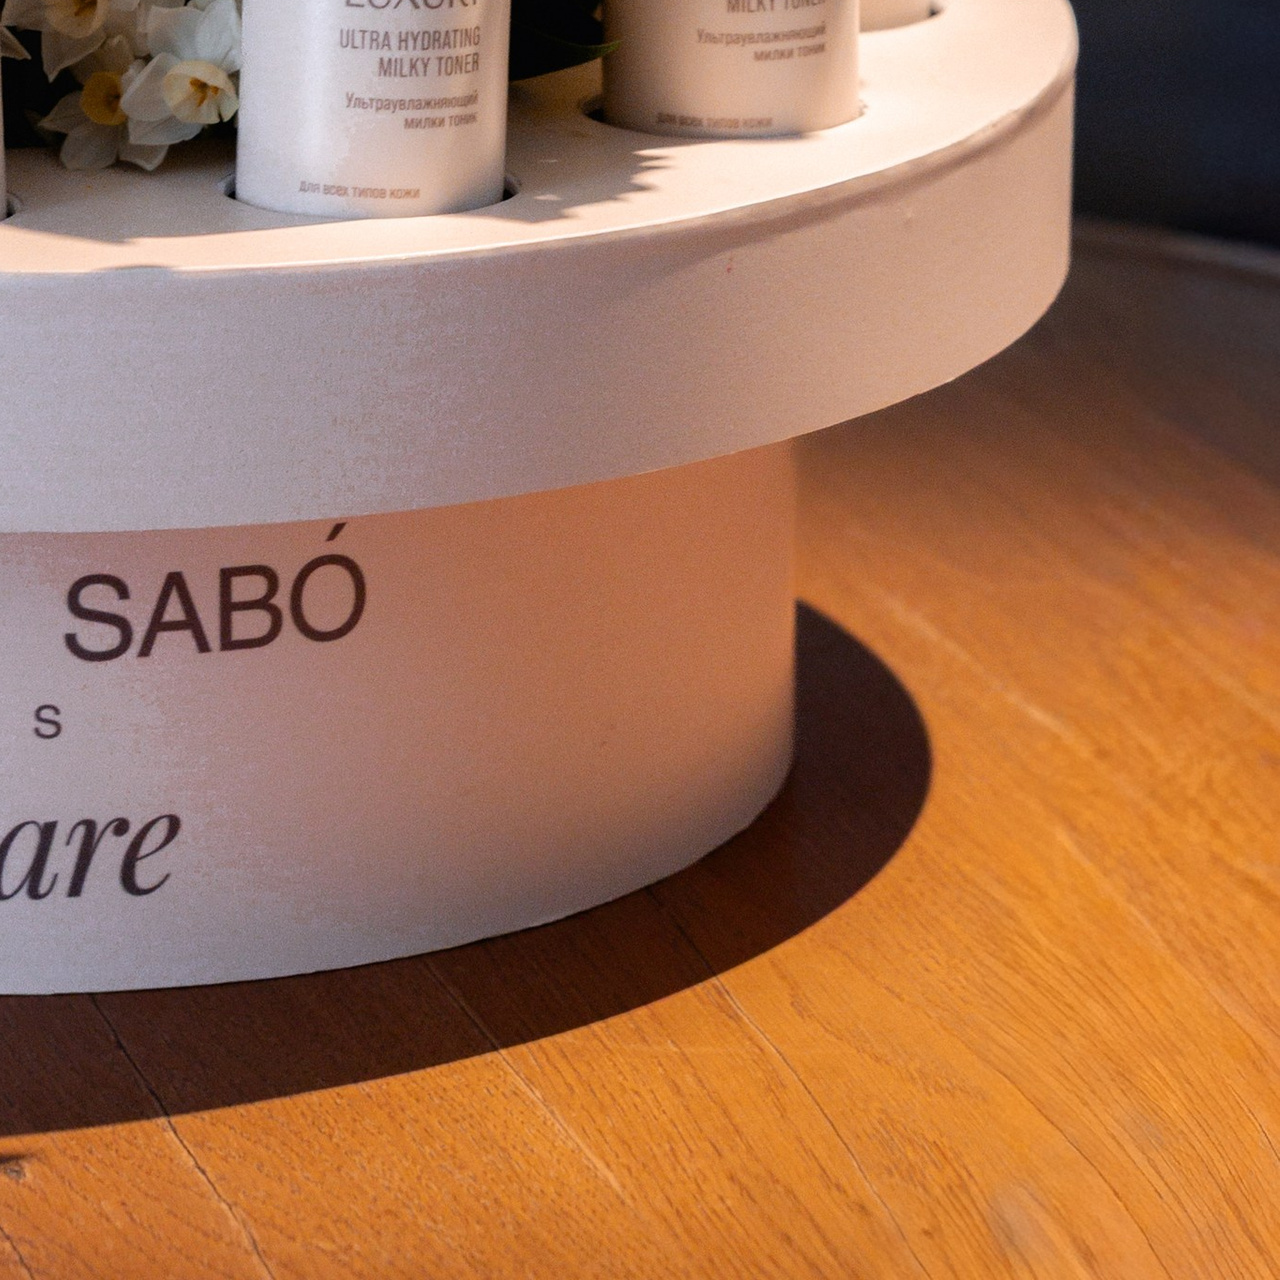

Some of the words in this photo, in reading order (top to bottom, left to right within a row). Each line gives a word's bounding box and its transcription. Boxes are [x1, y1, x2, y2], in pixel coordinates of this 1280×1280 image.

[339, 28, 392, 51] ULTRA
[397, 25, 481, 51] HYDRATING
[378, 56, 431, 79] MILKY
[436, 52, 480, 77] TONER
[64, 521, 368, 664] SABÓ
